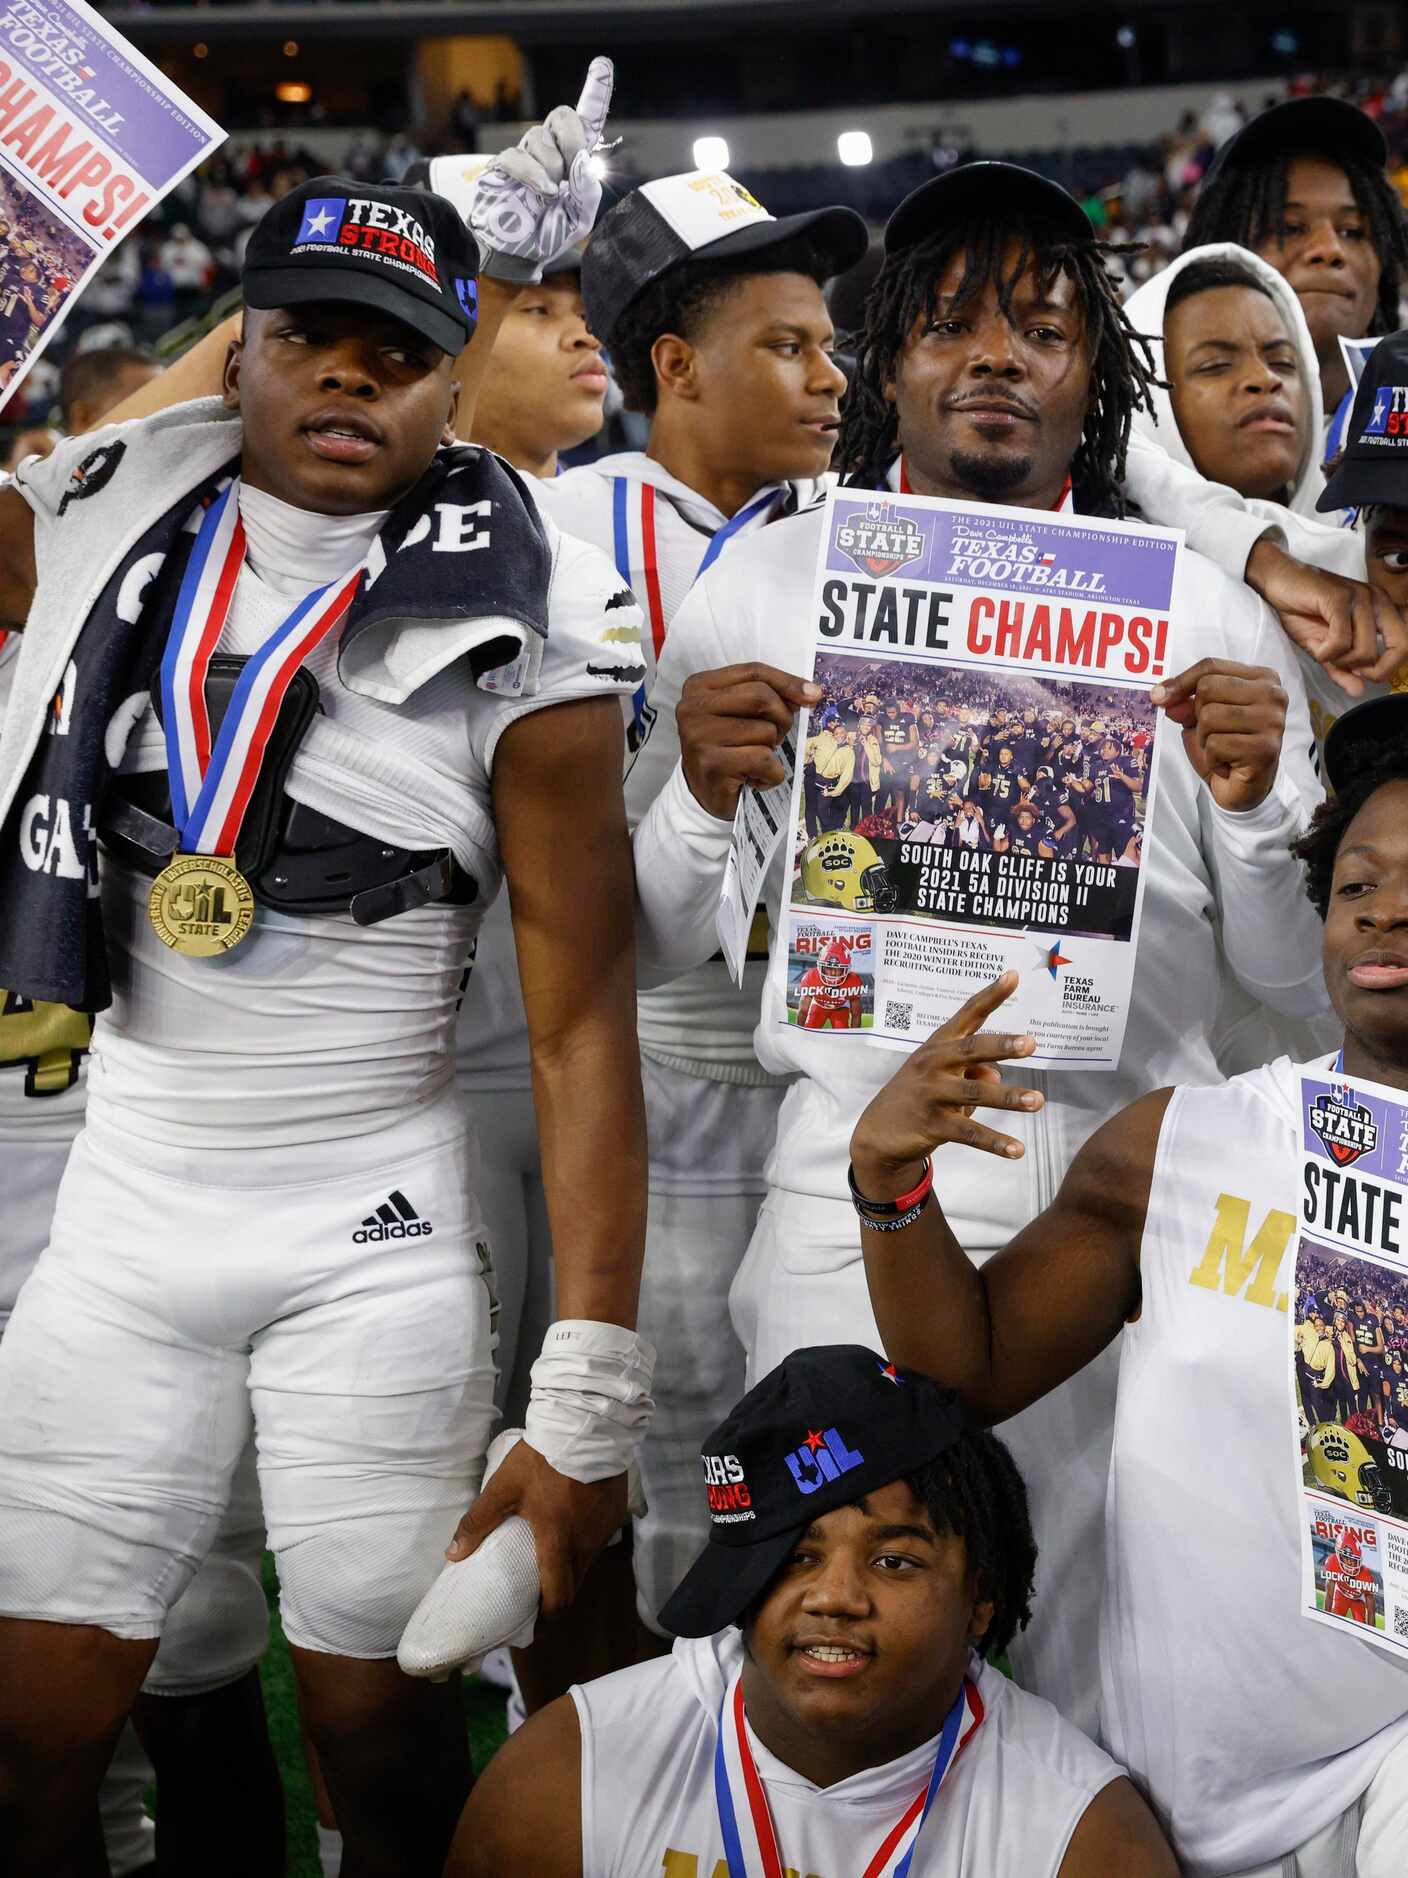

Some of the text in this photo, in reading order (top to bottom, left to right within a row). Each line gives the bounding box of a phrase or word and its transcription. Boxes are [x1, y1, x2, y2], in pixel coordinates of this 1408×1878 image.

[106, 49, 171, 110] CHAMPIONSHIP
[170, 108, 208, 145] EDITION
[347, 199, 435, 264] TEXAS
[339, 224, 440, 282] STRONG
[351, 248, 382, 262] STATE
[837, 527, 920, 556] STATE
[859, 521, 904, 534] FOOTBALL
[952, 515, 1173, 555] THE 2021 UIL STATE CHAMPIONSHIP EDITION
[952, 524, 1033, 546] Dave Campbell's
[853, 547, 903, 561] CHAMPIONSHIPS
[950, 536, 1038, 564] TEXAS
[946, 553, 1107, 593] FOOTBALL
[820, 579, 1167, 676] STATE CHAMPS!
[899, 844, 1118, 887] SOUTH OAK CLIFF IS YOUR
[917, 867, 1089, 906] 2021 5A DIVISION II
[915, 888, 1070, 924] STATE CHAMPIONS
[178, 923, 220, 936] STATE
[1303, 1161, 1402, 1254] STATE
[352, 1220, 434, 1245] adidas
[700, 1454, 745, 1486] XAS
[783, 1427, 865, 1495] UIL
